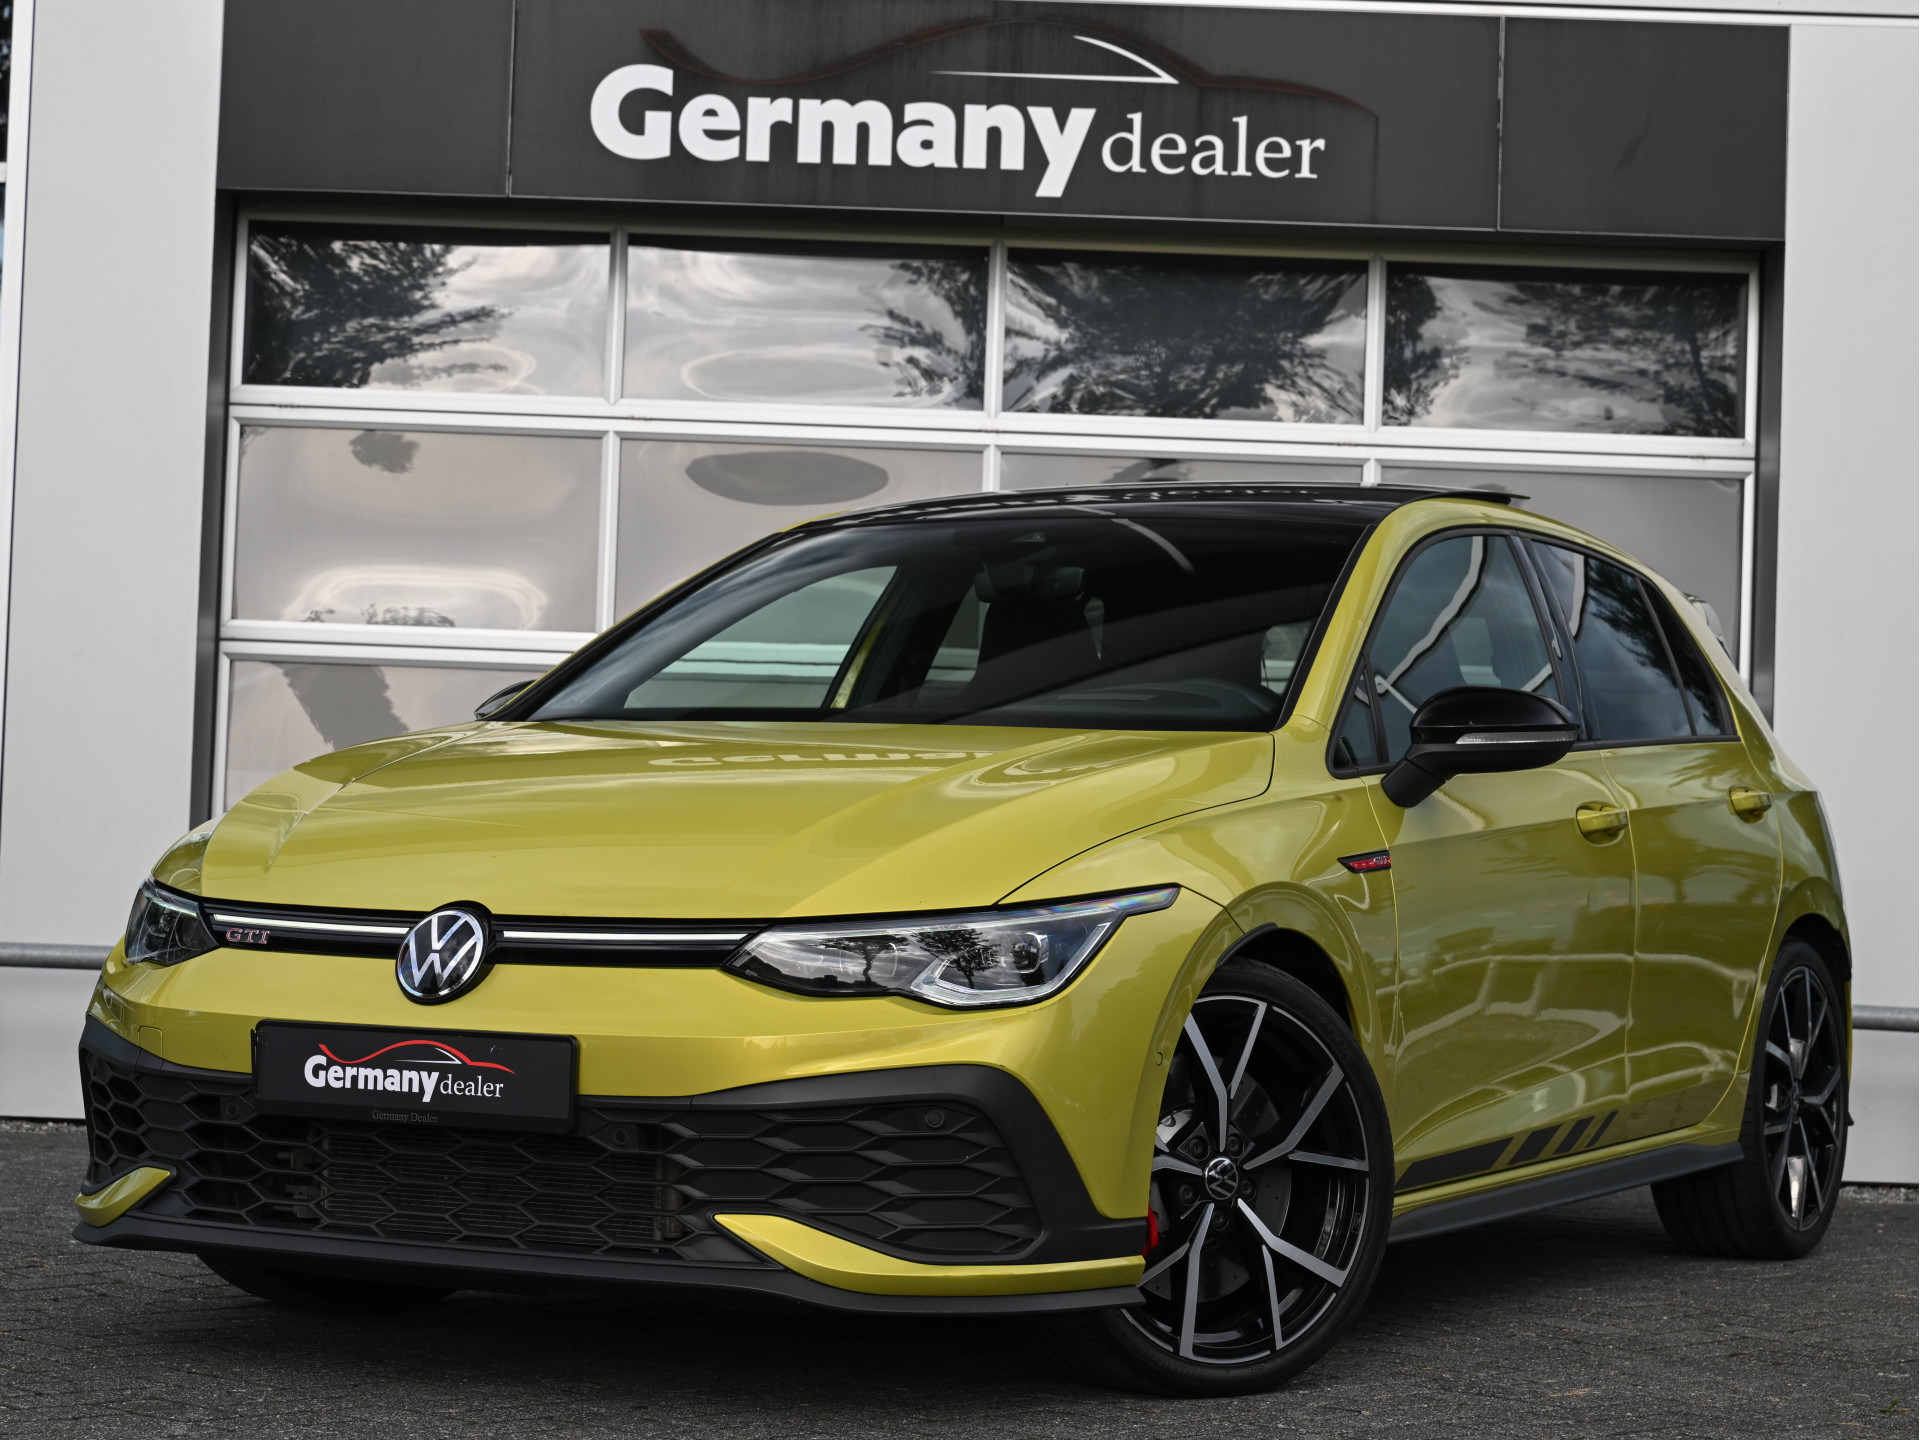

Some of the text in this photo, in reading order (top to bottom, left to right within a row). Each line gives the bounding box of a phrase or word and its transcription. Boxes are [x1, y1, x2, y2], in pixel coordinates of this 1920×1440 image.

[590, 63, 1326, 198] Germany dealer
[226, 928, 270, 944] GTI
[303, 1054, 504, 1103] Germany dealer
[371, 1109, 438, 1123] Germany Dealer
